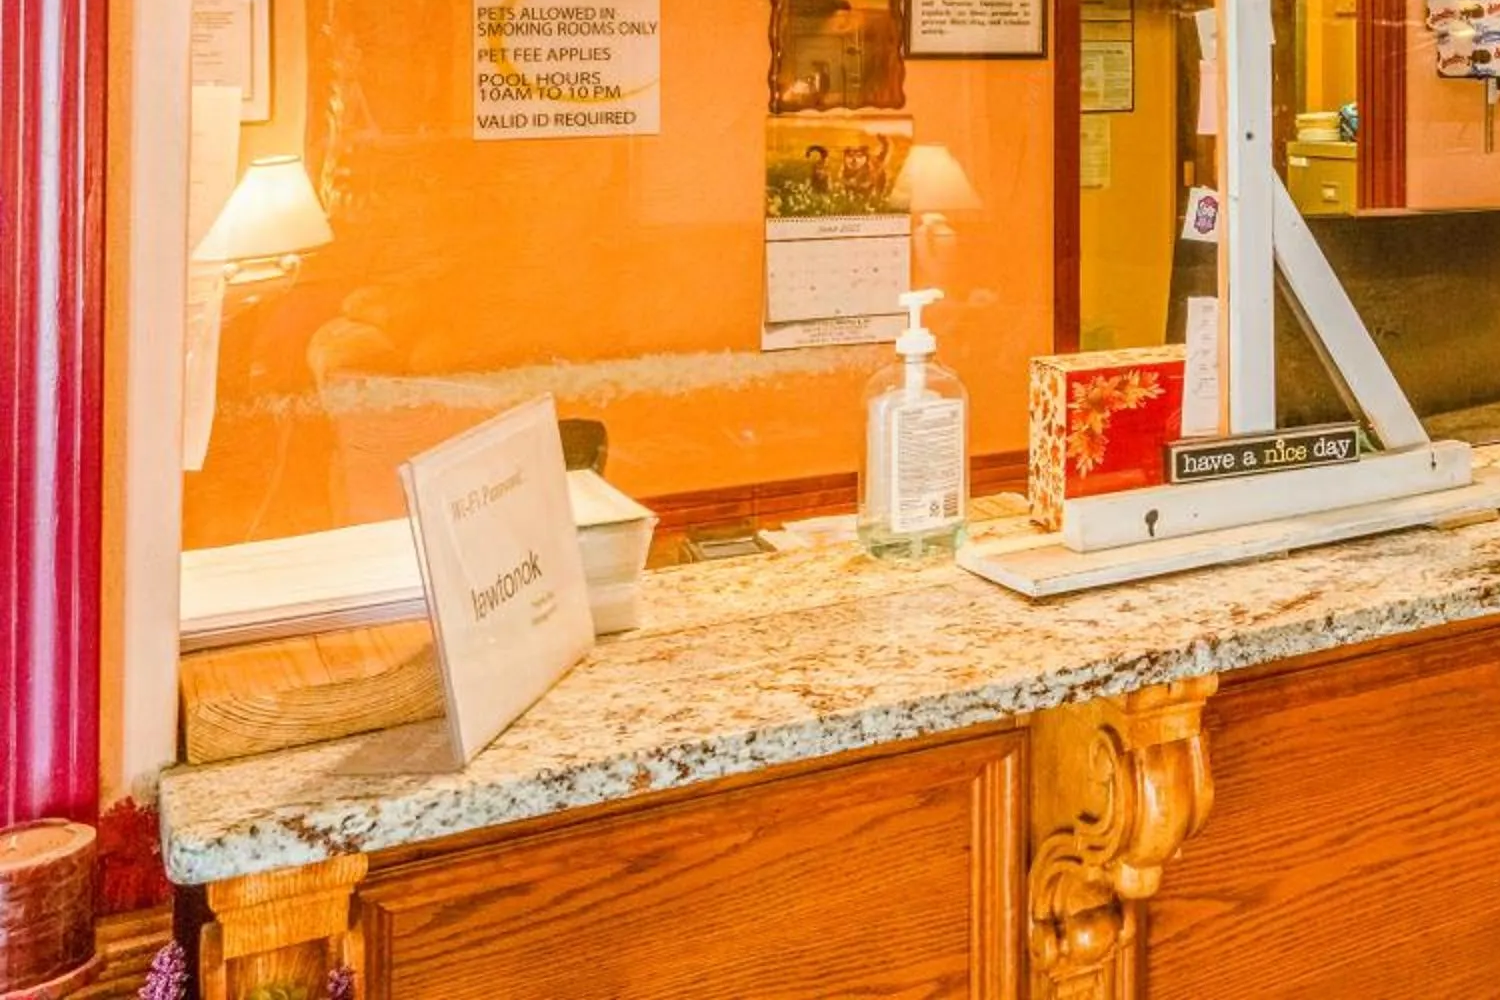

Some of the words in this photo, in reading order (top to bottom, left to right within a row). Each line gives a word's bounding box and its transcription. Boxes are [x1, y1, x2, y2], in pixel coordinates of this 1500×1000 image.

[477, 7, 516, 21] PETS
[519, 7, 597, 21] ALLOWED
[600, 6, 615, 20] IN
[477, 22, 552, 37] SMOKING
[557, 22, 615, 36] ROOMS
[619, 21, 658, 36] ONLY
[477, 48, 508, 62] PET
[513, 48, 542, 62] FEE
[546, 47, 612, 62] APPLIES
[478, 73, 530, 87] POOL
[536, 72, 601, 86] HOURS
[480, 87, 532, 101] 10AM
[537, 86, 563, 100] TO
[569, 86, 589, 99] 10
[593, 85, 622, 99] PM
[477, 113, 528, 129] VALID
[532, 113, 549, 127] ID
[554, 111, 637, 128] REQUIRED
[1182, 450, 1235, 473] have
[1243, 450, 1257, 466] a
[1263, 439, 1308, 464] nice
[1312, 436, 1351, 460] day
